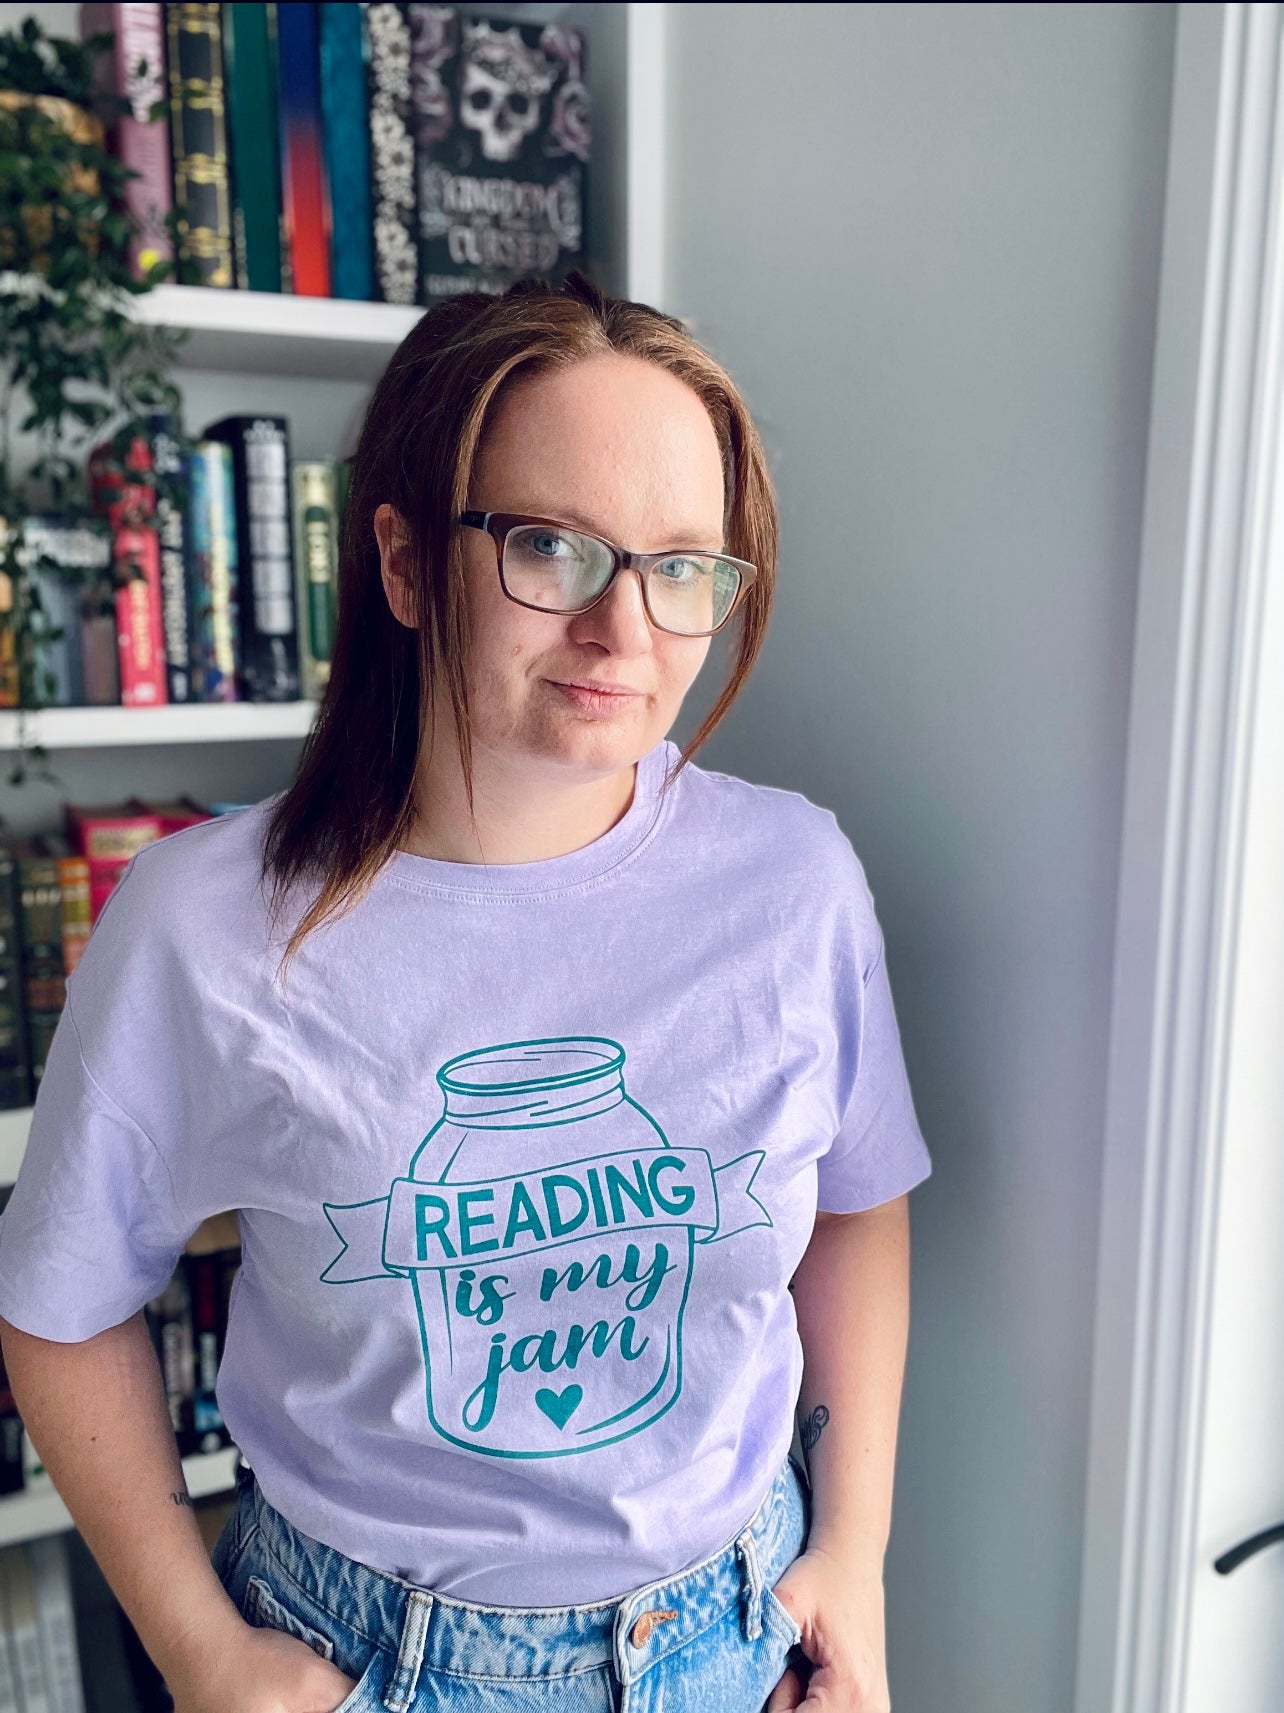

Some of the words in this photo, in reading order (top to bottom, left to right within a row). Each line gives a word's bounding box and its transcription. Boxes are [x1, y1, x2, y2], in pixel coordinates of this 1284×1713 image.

[414, 1155, 696, 1262] READING
[454, 1268, 517, 1326] is
[539, 1242, 678, 1312] my
[462, 1315, 650, 1433] jam
